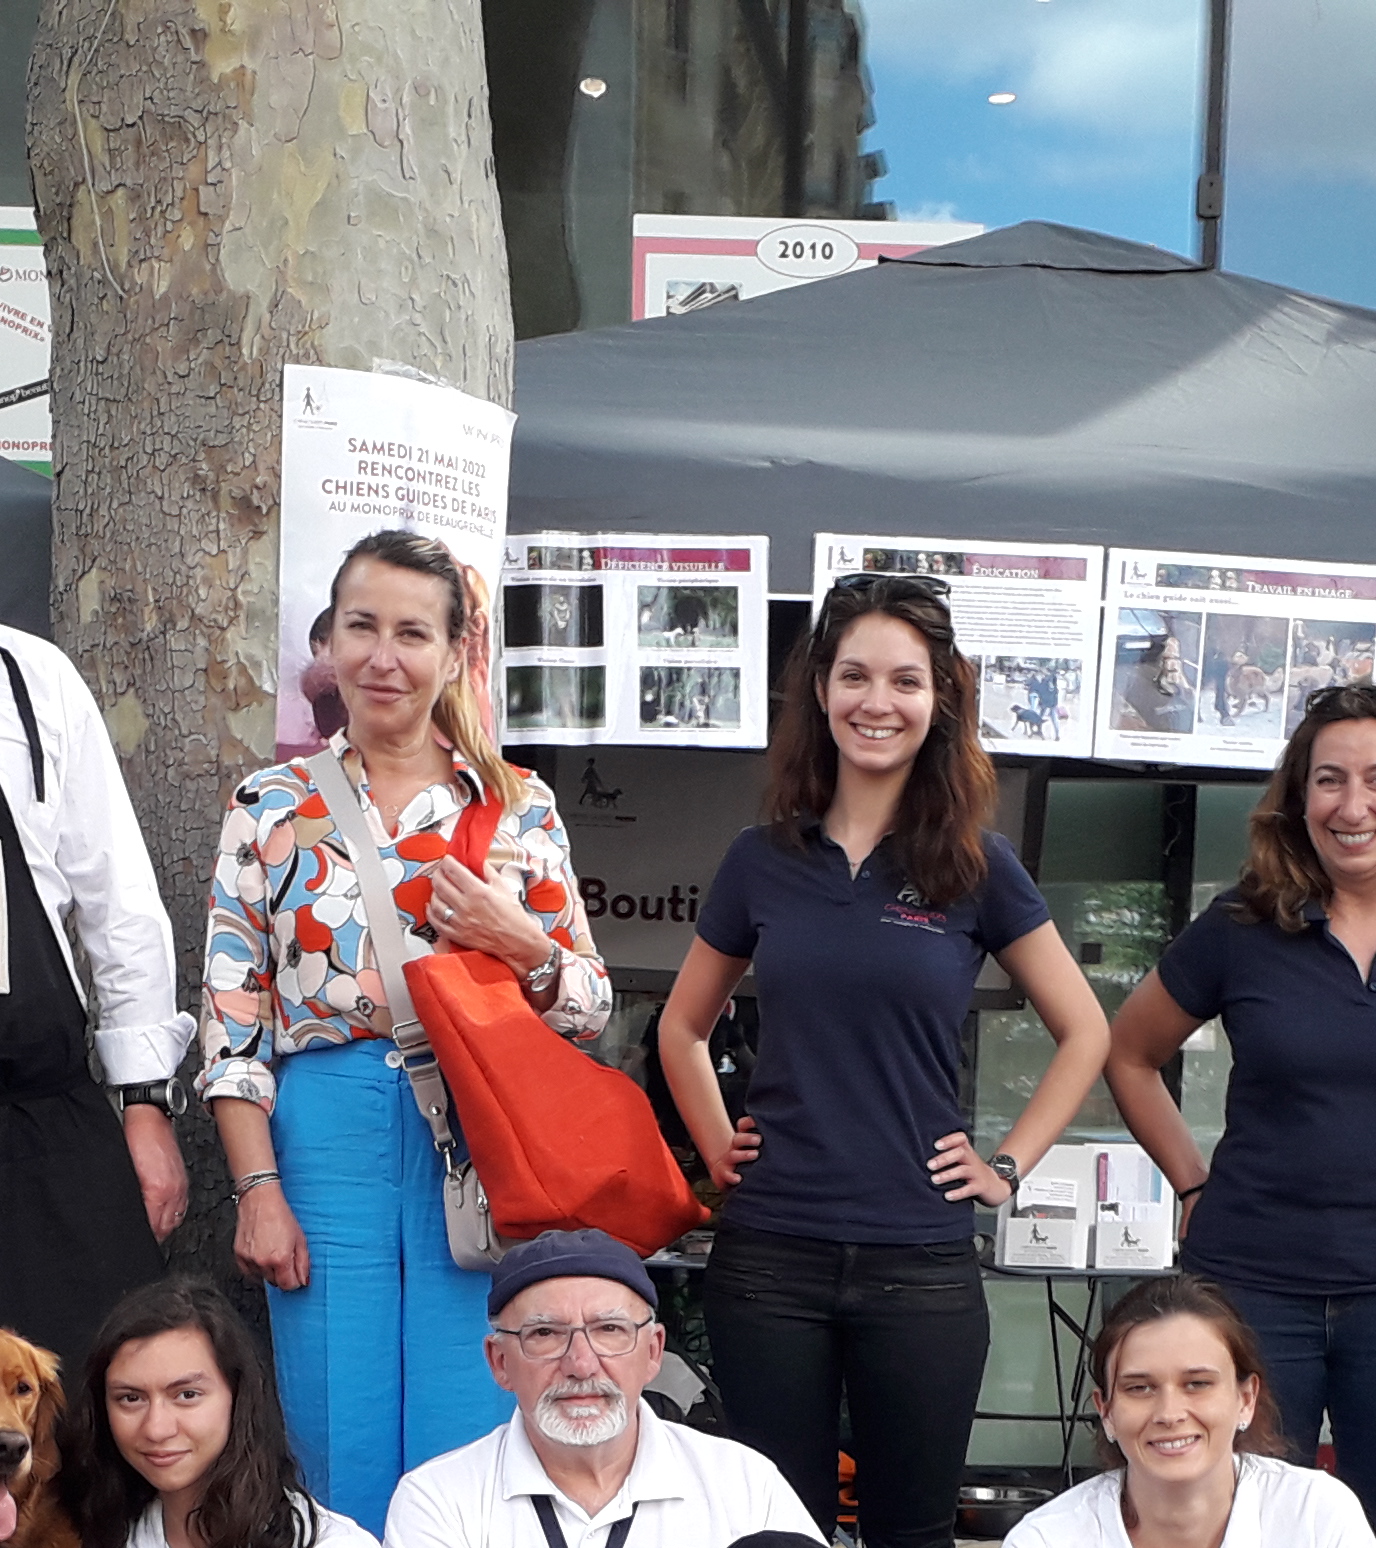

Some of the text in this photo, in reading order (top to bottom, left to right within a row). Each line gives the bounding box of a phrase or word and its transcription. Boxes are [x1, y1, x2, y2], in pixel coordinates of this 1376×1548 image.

[778, 240, 833, 260] 2010
[14, 269, 49, 282] MON
[29, 316, 45, 329] EN
[348, 437, 486, 479] SAMEDI 21 MAI 2022
[358, 460, 481, 497] RENCONTREZ LES
[322, 479, 390, 500] CHIENS
[395, 487, 447, 511] GUIDES
[451, 498, 467, 515] DE
[329, 501, 347, 513] AU
[350, 502, 415, 520] MONOPRIX
[418, 510, 430, 523] DE
[672, 561, 725, 571] VISUELLE
[1246, 582, 1293, 595] TRAVAIL
[1296, 587, 1313, 596] EN
[579, 876, 700, 922] Bouti
